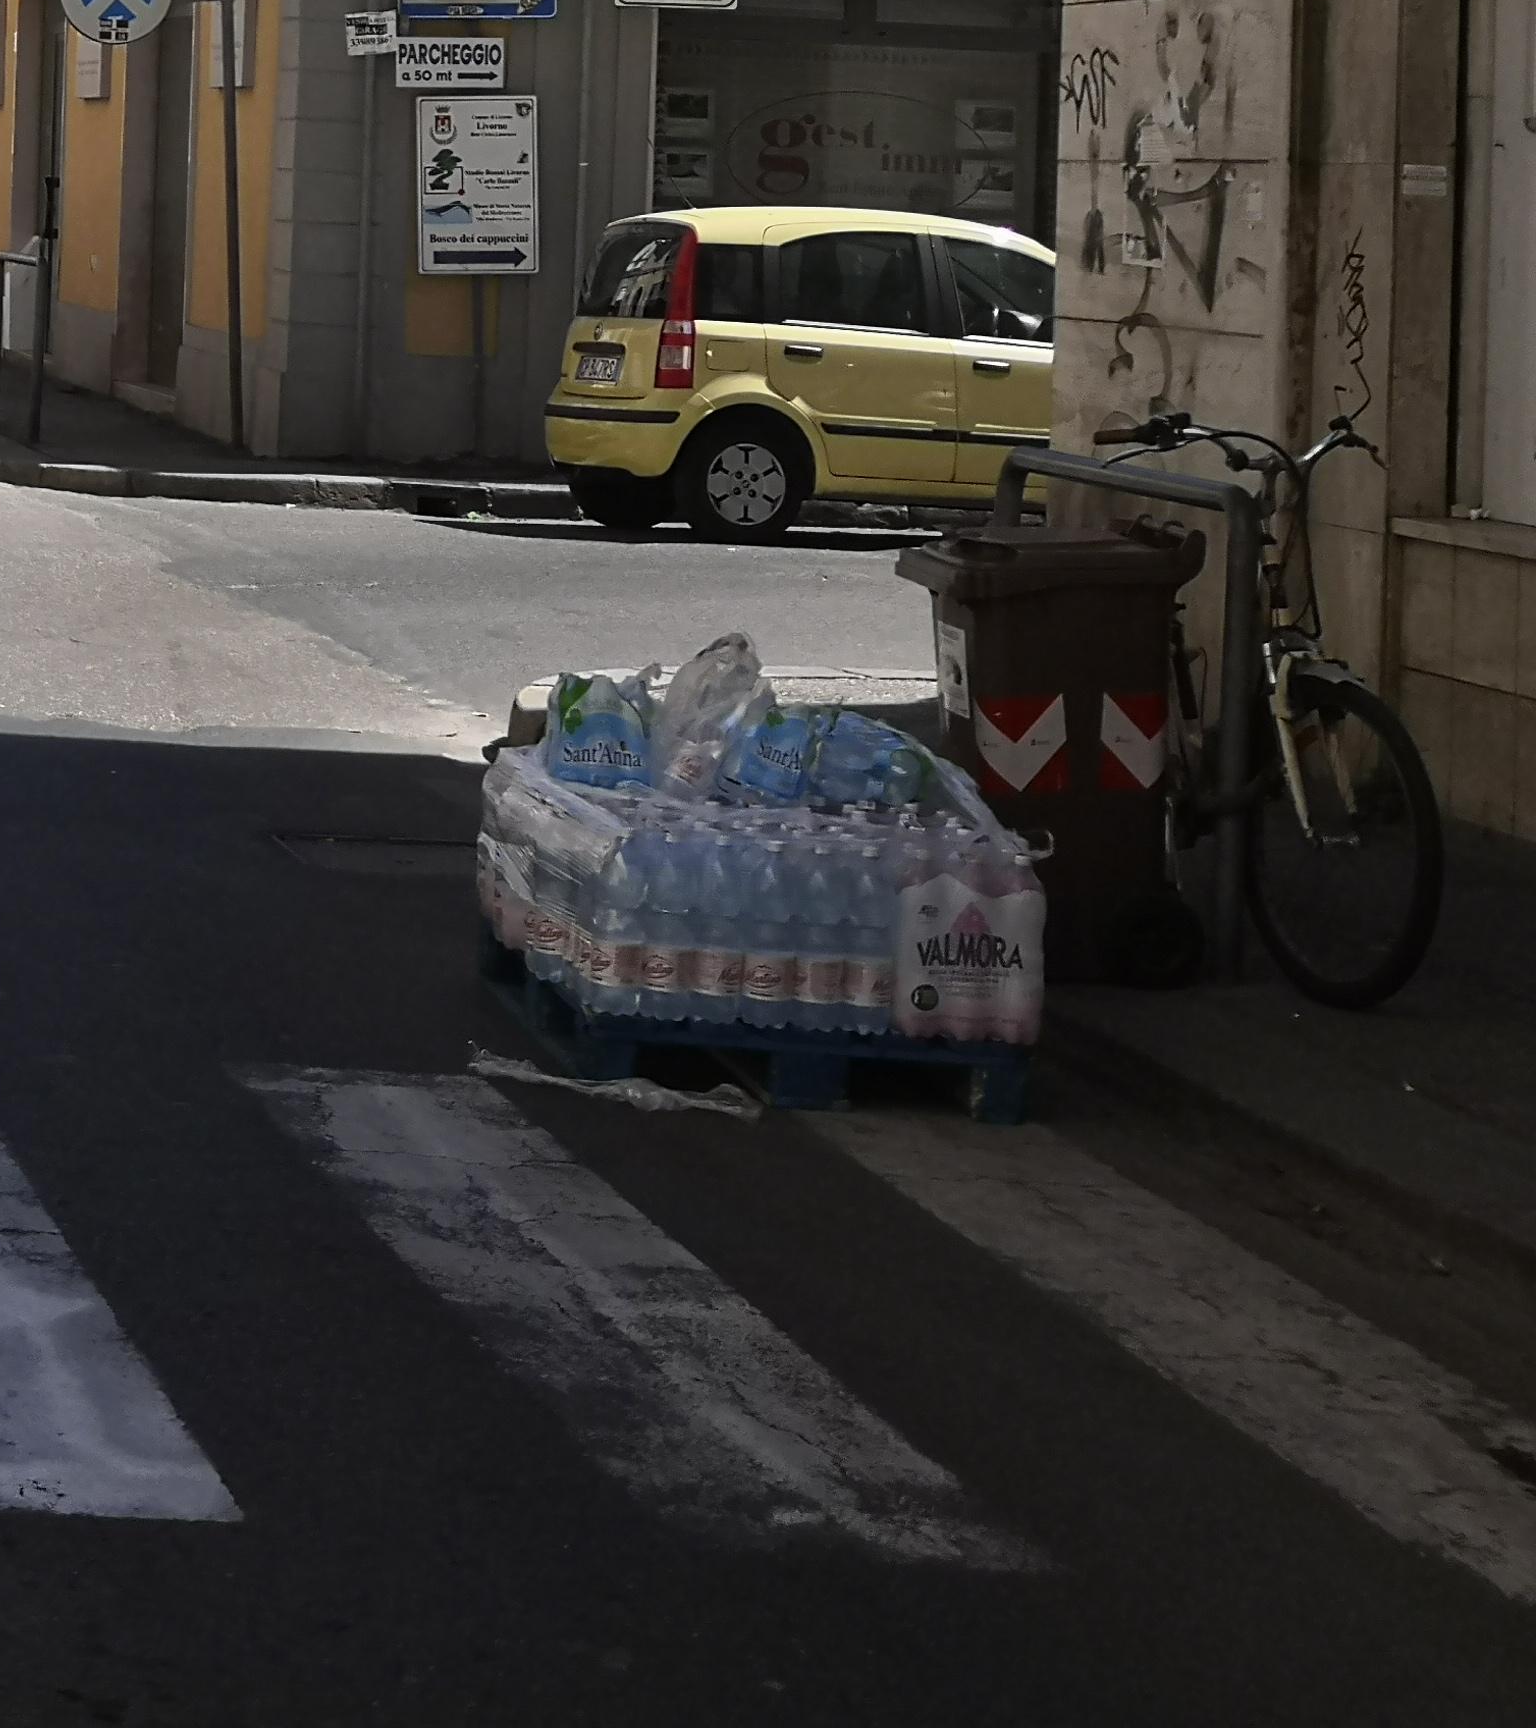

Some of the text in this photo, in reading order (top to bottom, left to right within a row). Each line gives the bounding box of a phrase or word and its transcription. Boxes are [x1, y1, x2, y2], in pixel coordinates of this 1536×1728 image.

[398, 43, 502, 66] PARCHEGGIO
[402, 70, 453, 81] a 50 mt
[476, 122, 508, 130] Livorno
[429, 233, 529, 245] Bosco dei cappuccini
[563, 741, 643, 768] Sant'Anna
[916, 932, 1024, 970] VALMORA
